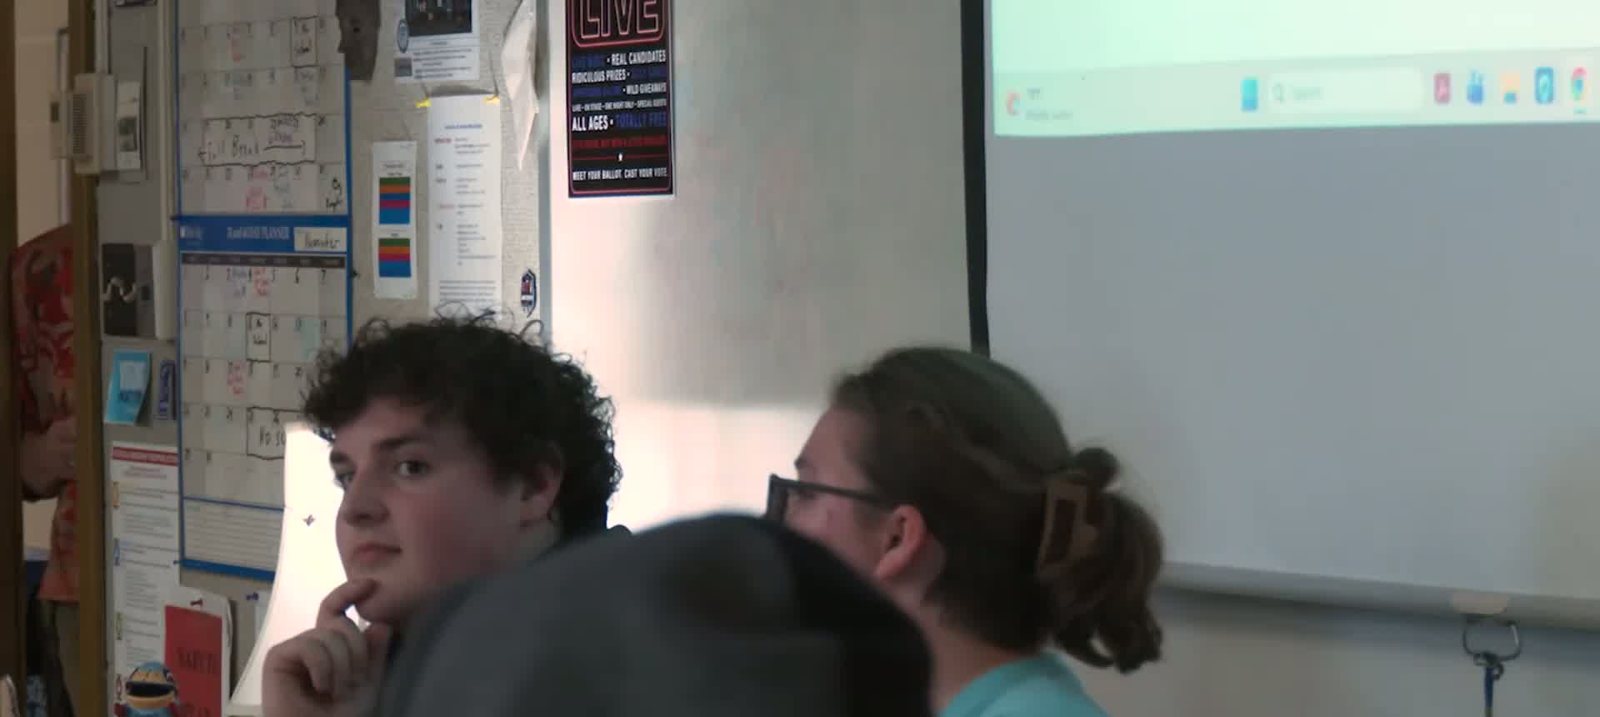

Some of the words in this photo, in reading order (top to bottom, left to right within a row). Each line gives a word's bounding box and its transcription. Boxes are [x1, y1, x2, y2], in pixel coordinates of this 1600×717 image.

[611, 53, 627, 66] REAL
[628, 50, 666, 64] CANDIDATES
[572, 71, 605, 83] RIDICULOUS
[606, 69, 626, 81] PRIZES
[626, 84, 640, 95] WILD
[572, 116, 587, 132] ALL
[588, 114, 609, 131] AGES
[572, 171, 587, 181] MEET
[587, 170, 601, 180] YOUR
[624, 168, 638, 179] CAST
[638, 167, 653, 178] YOUR
